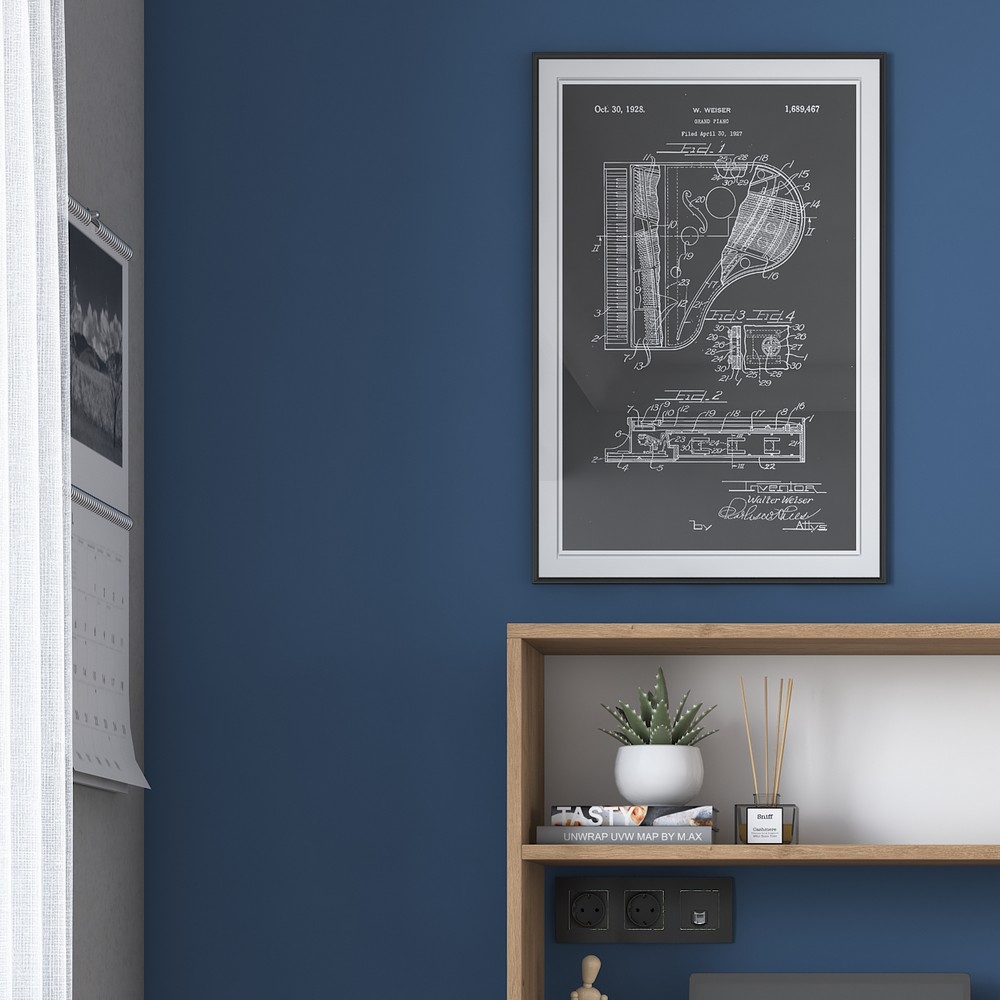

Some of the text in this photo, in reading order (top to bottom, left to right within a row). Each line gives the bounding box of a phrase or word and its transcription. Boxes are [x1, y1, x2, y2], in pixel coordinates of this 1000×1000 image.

[594, 105, 645, 114] Oct. 30, 1928.
[784, 105, 820, 114] 1,689,467
[556, 806, 635, 826] TASTY
[563, 832, 703, 841] UNWRAP UVW MAP BY M.AX
